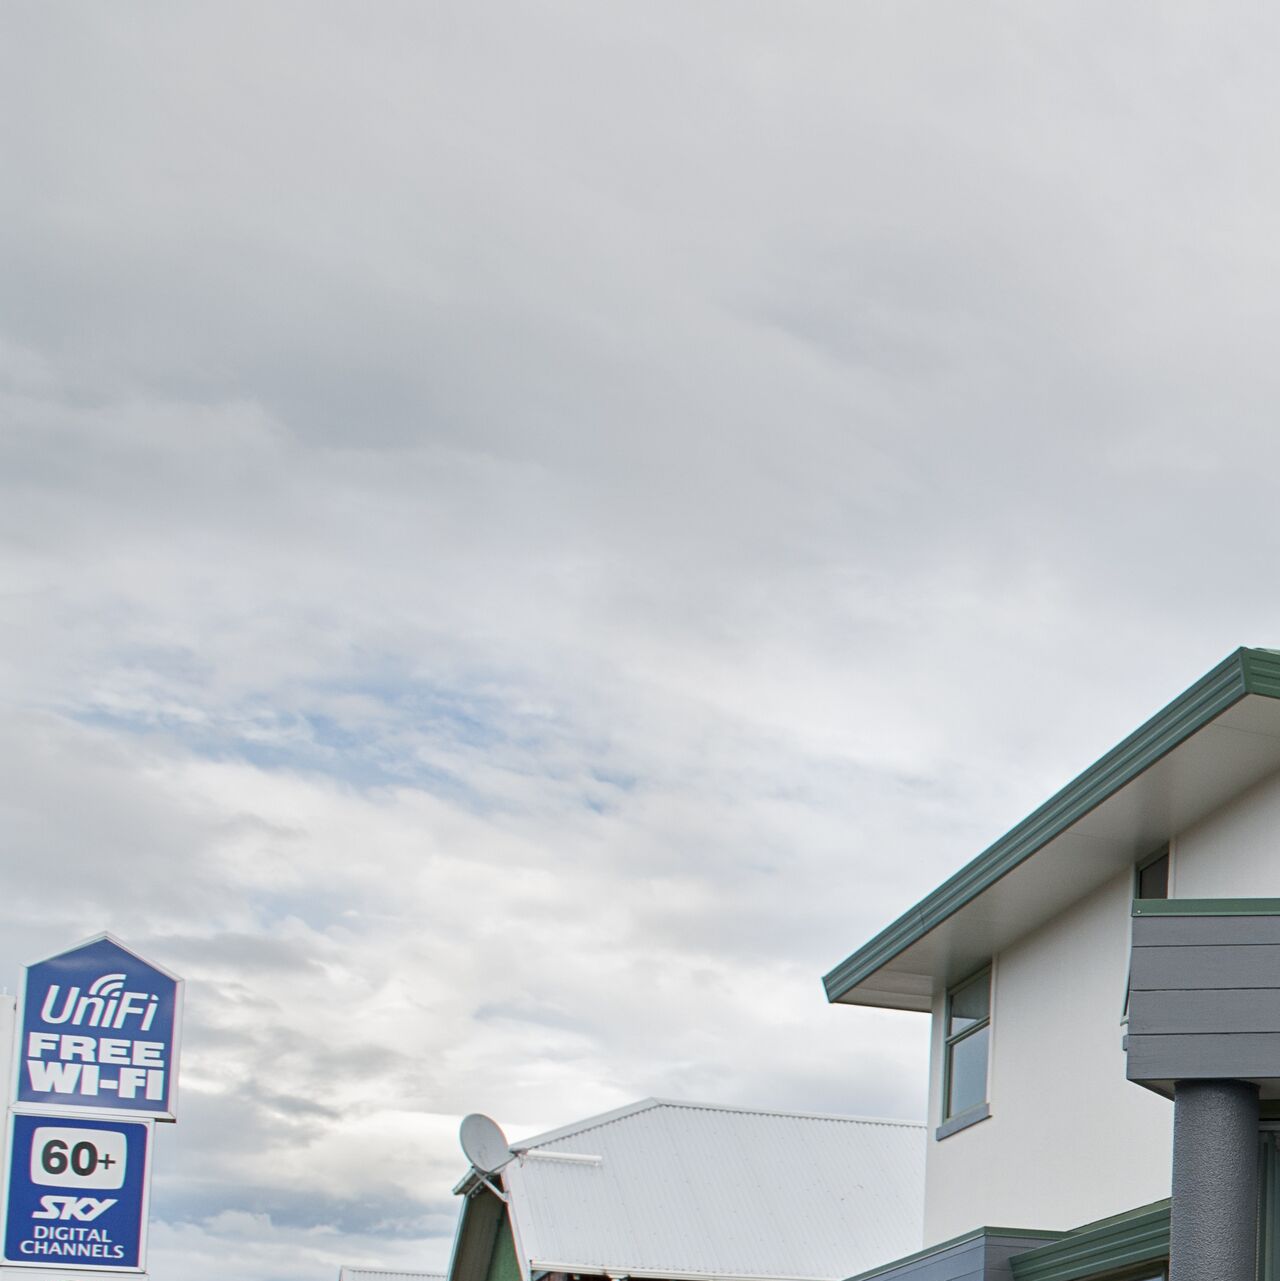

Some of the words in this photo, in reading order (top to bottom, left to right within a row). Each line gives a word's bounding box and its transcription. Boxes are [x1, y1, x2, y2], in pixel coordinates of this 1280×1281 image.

[40, 984, 160, 1032] UniFi
[28, 1031, 165, 1068] FREE
[26, 1059, 165, 1101] WI-FI
[41, 1139, 116, 1176] 60+
[31, 1194, 119, 1221] SKY
[20, 1240, 125, 1259] CHANNELS
[33, 1225, 113, 1243] DIGITAL
